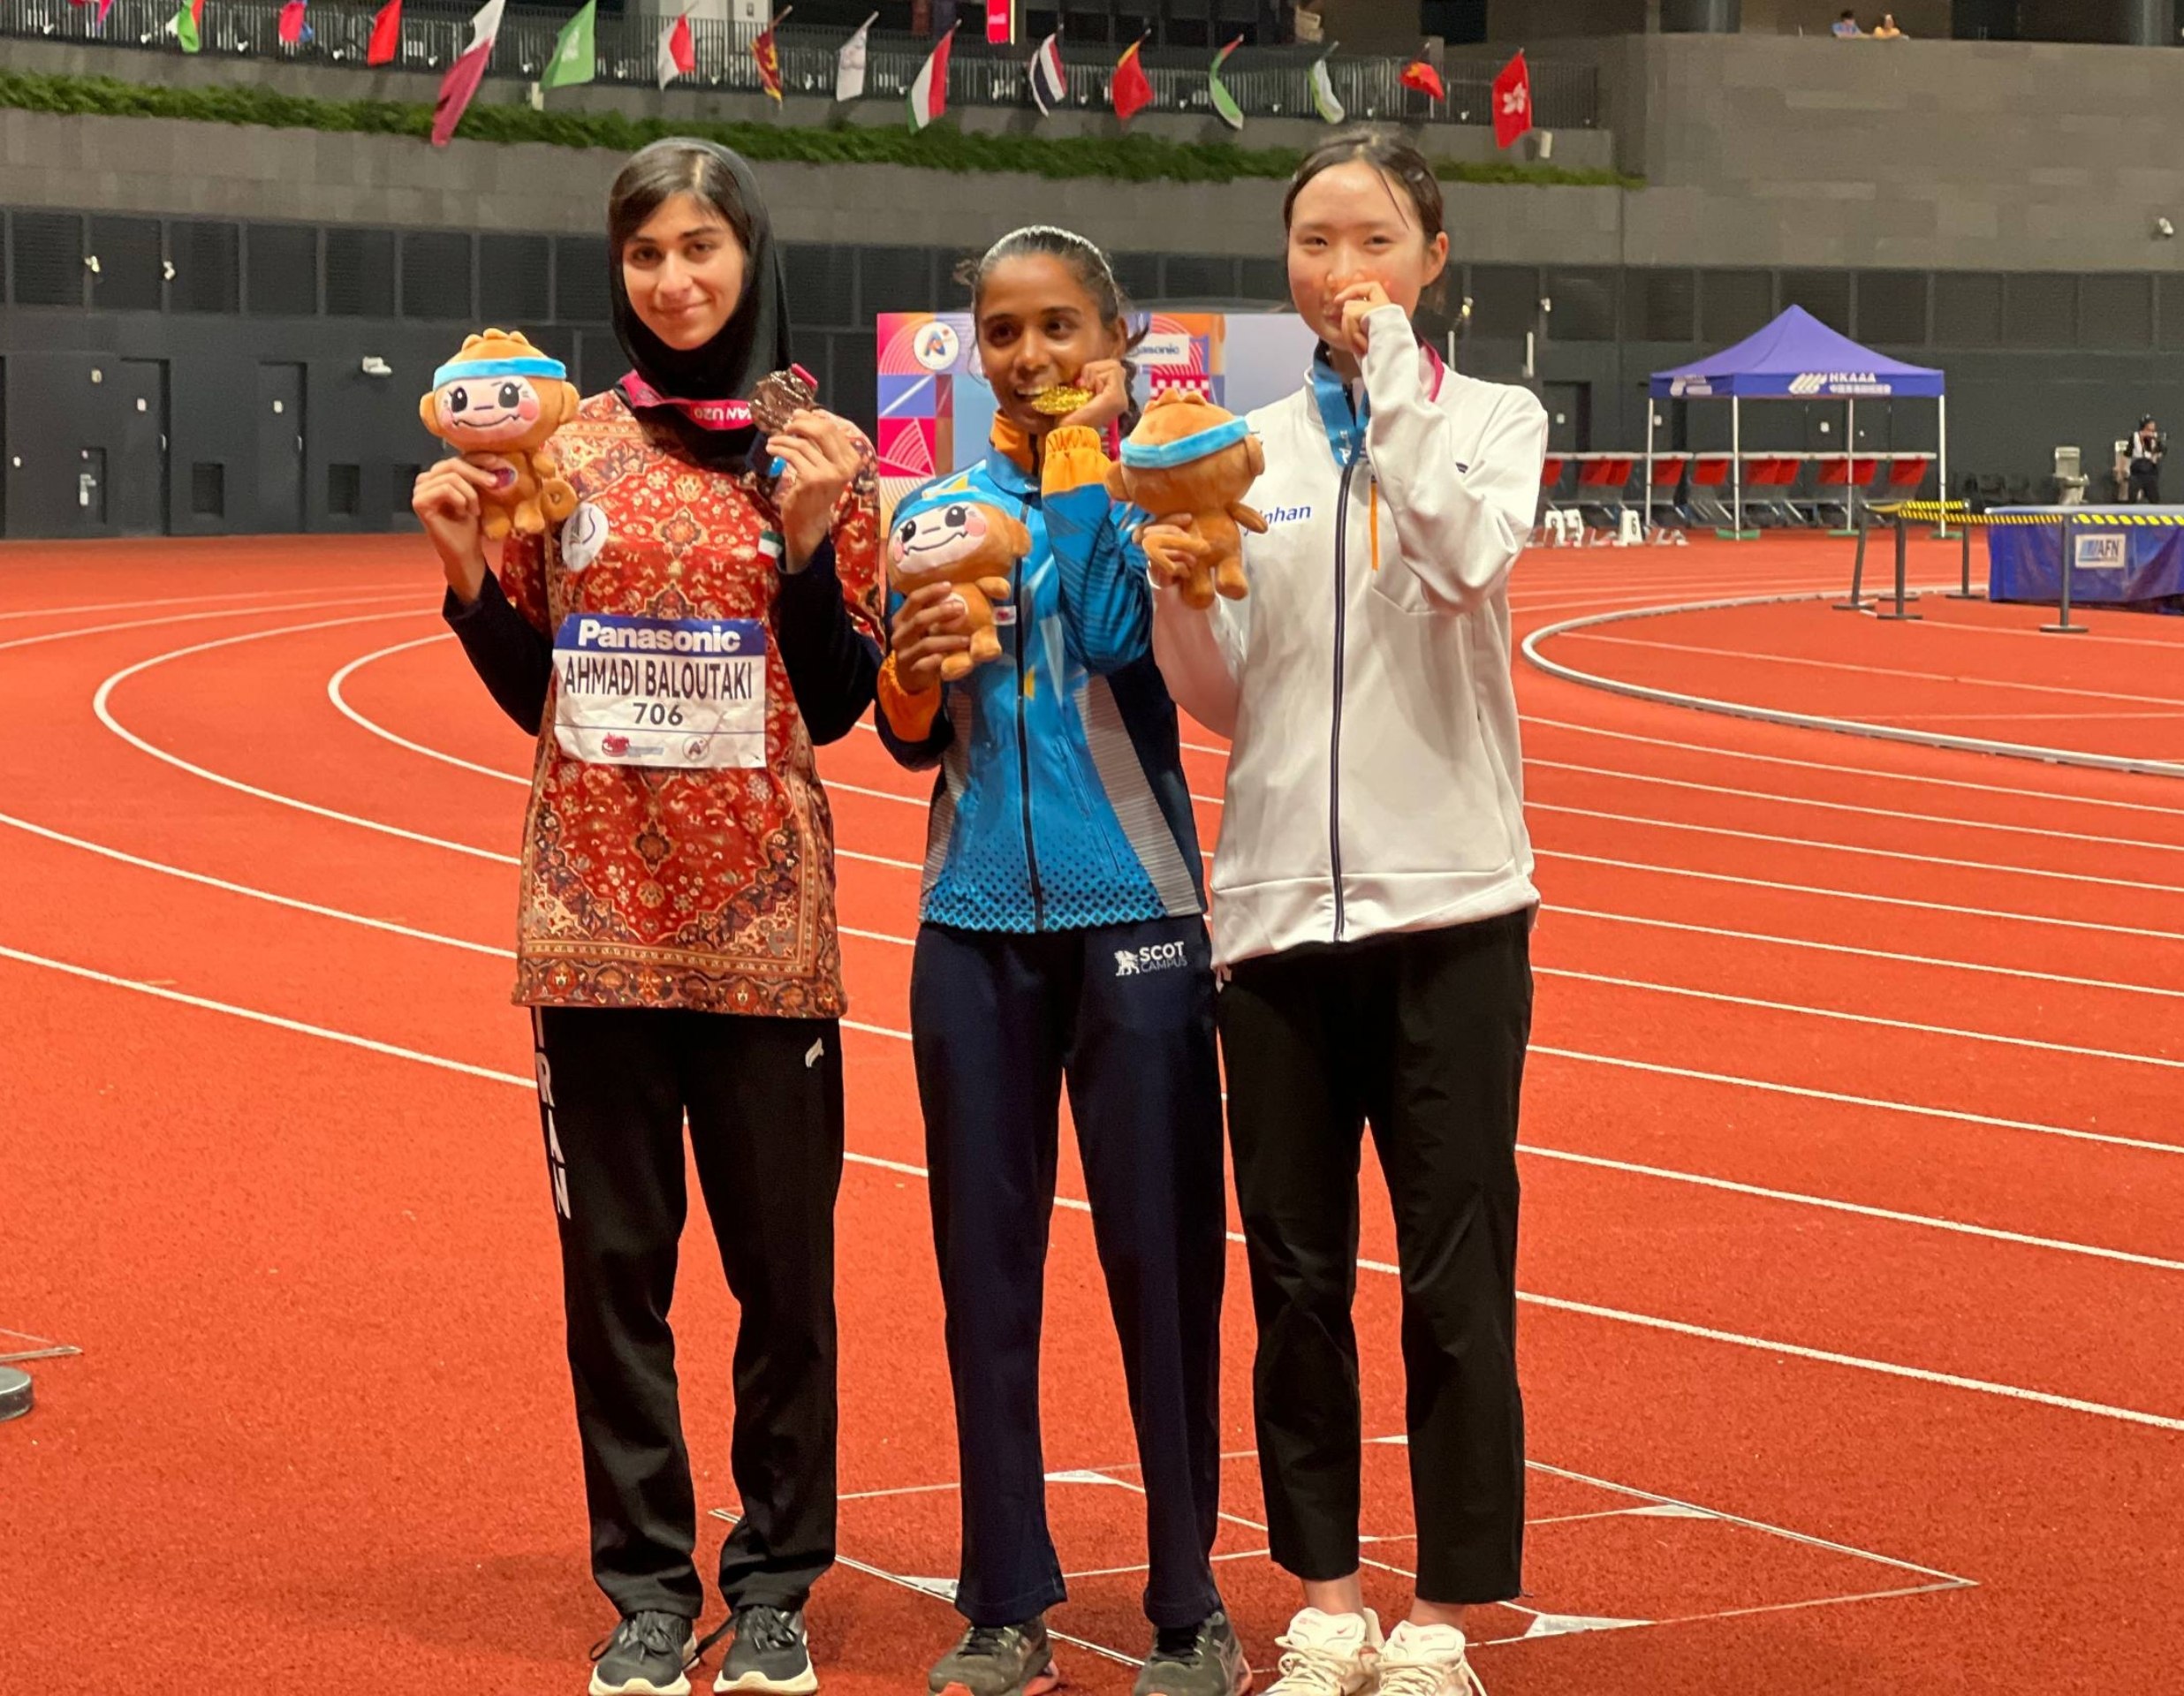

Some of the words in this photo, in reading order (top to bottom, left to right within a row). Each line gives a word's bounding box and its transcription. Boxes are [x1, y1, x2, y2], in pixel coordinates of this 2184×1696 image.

[578, 618, 741, 653] Panasonic
[564, 656, 639, 696] AHMADI
[645, 659, 752, 700] BALOUTAKI
[633, 702, 684, 727] 706
[1139, 941, 1185, 963] SCOT
[1141, 955, 1188, 973] CAMPUS
